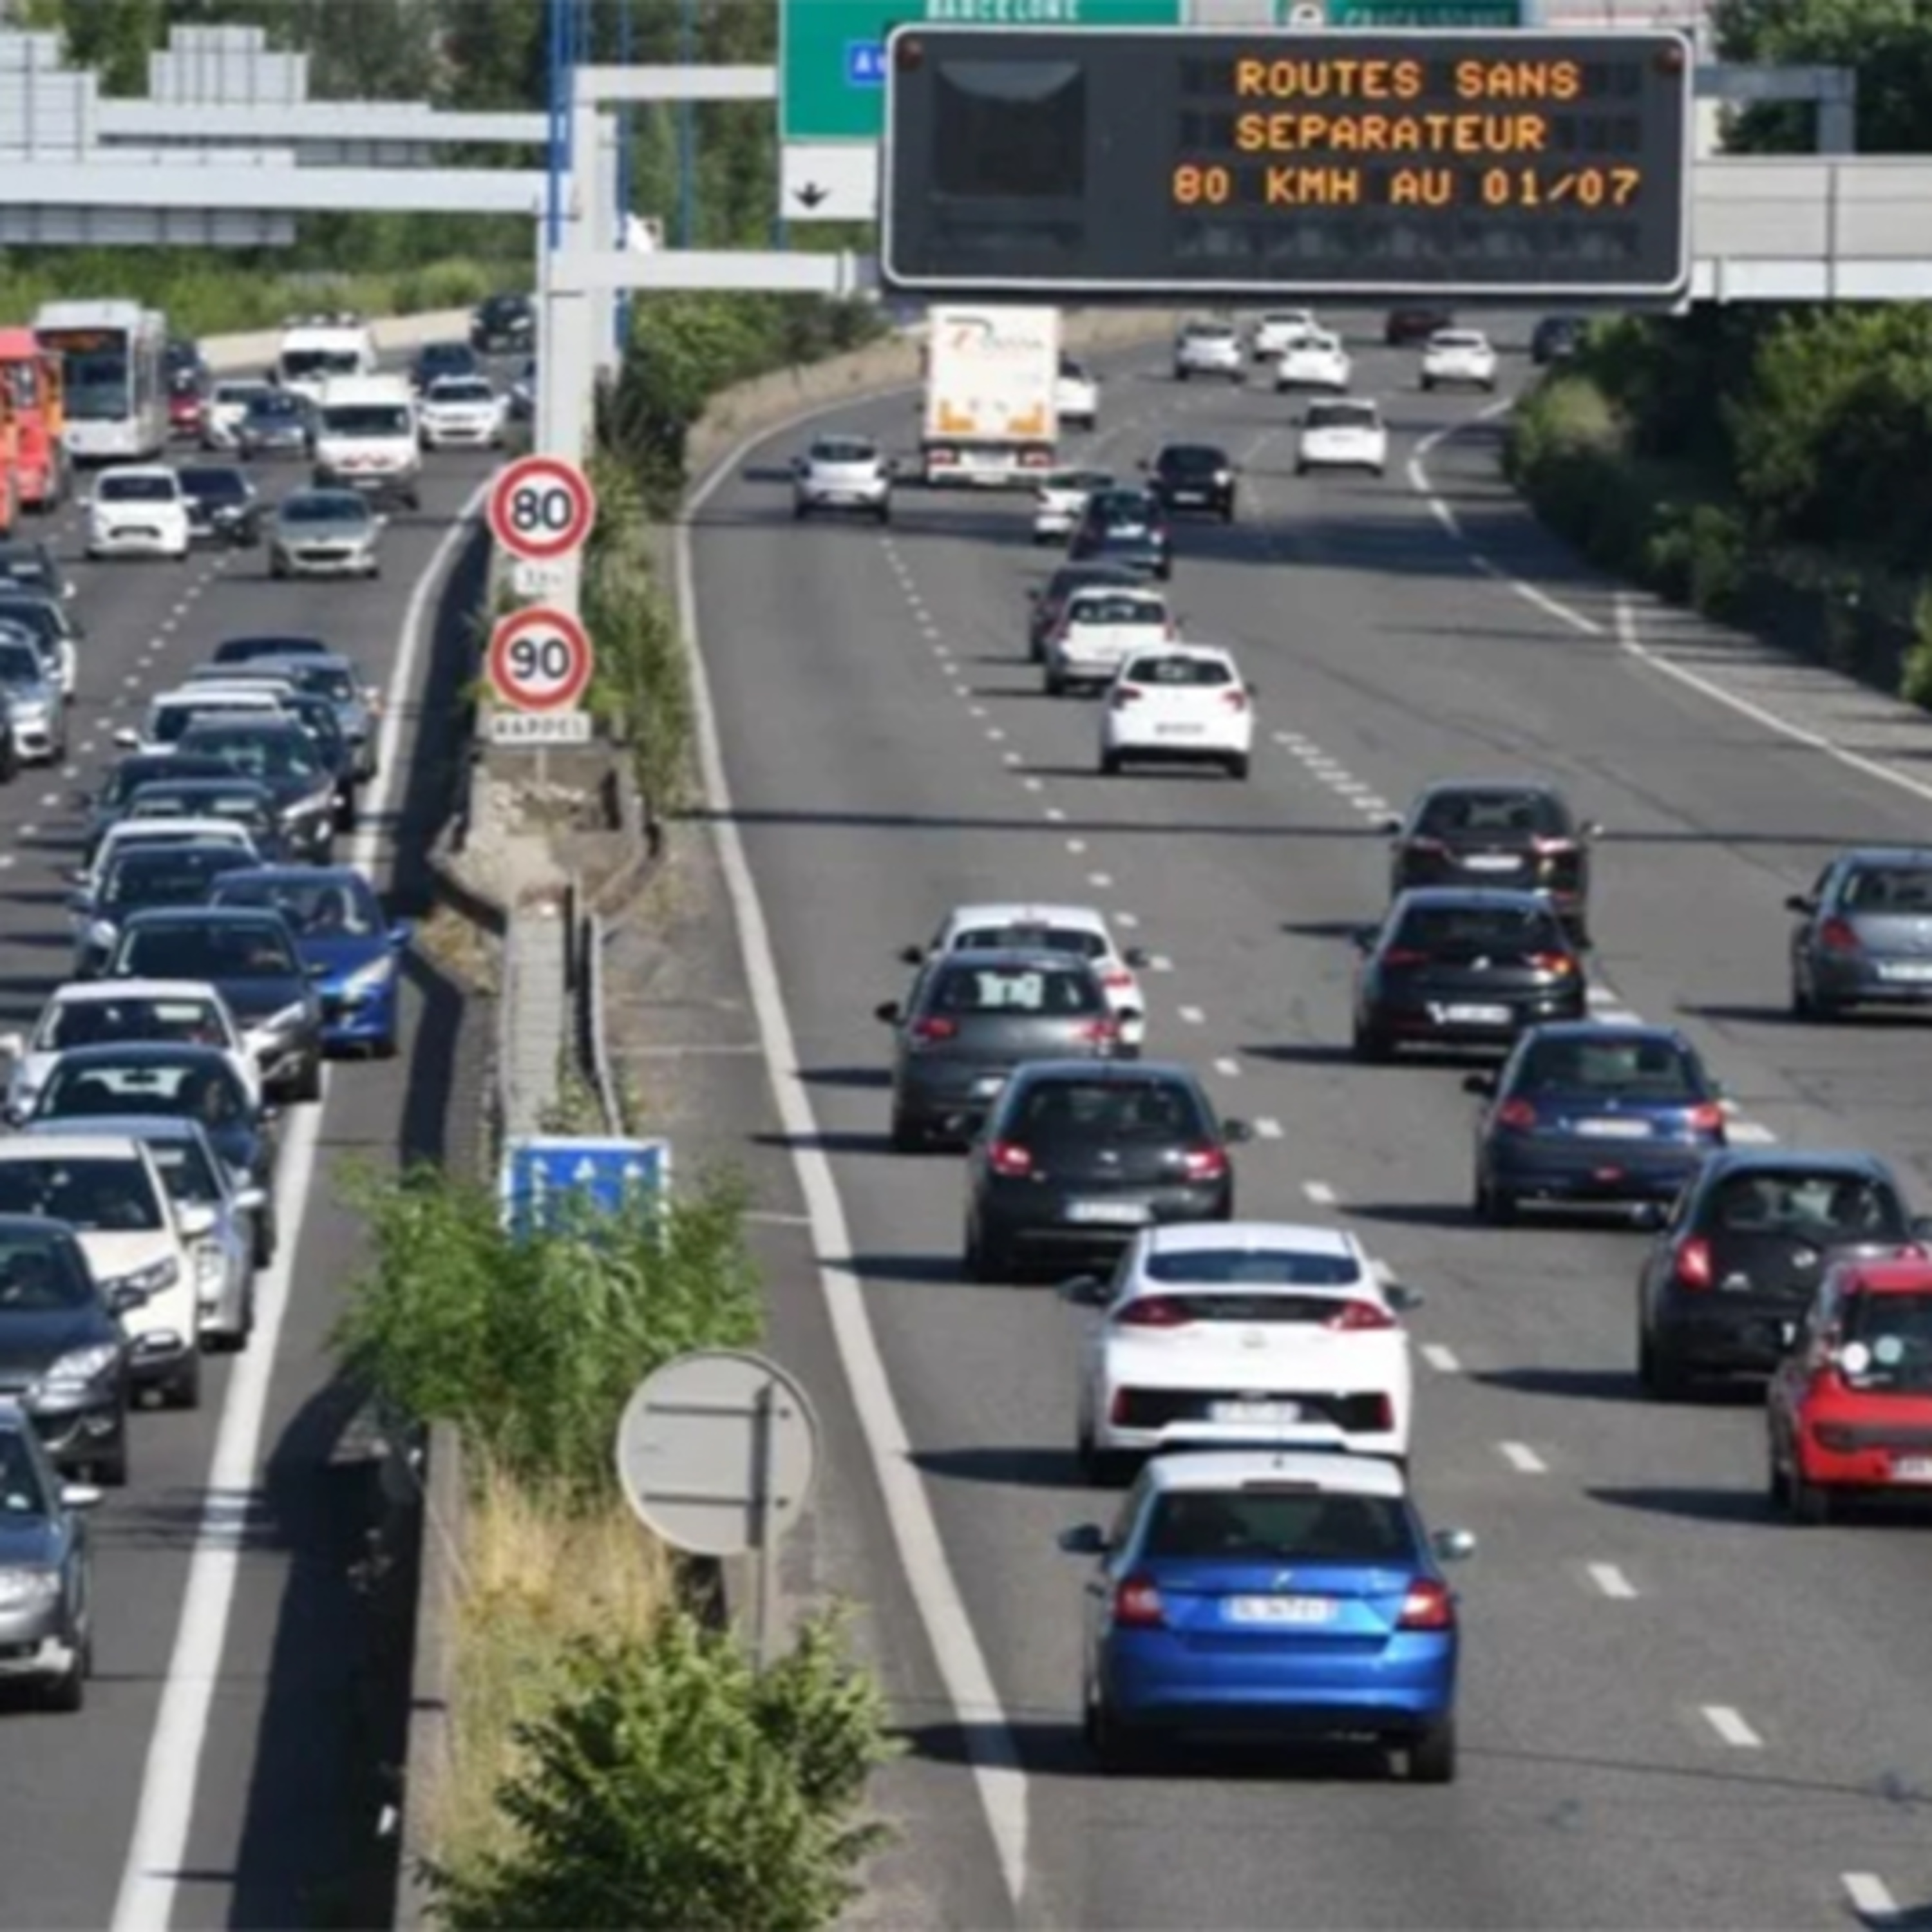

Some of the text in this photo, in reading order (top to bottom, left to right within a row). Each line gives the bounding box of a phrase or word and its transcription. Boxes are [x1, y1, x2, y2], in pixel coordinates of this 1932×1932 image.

[1236, 60, 1580, 99] ROUTES SANS
[1236, 114, 1546, 151] SEPARATEUR
[1173, 166, 1639, 205] 80 KMH AU 01/07
[513, 488, 573, 531] 80
[511, 638, 570, 679] 90
